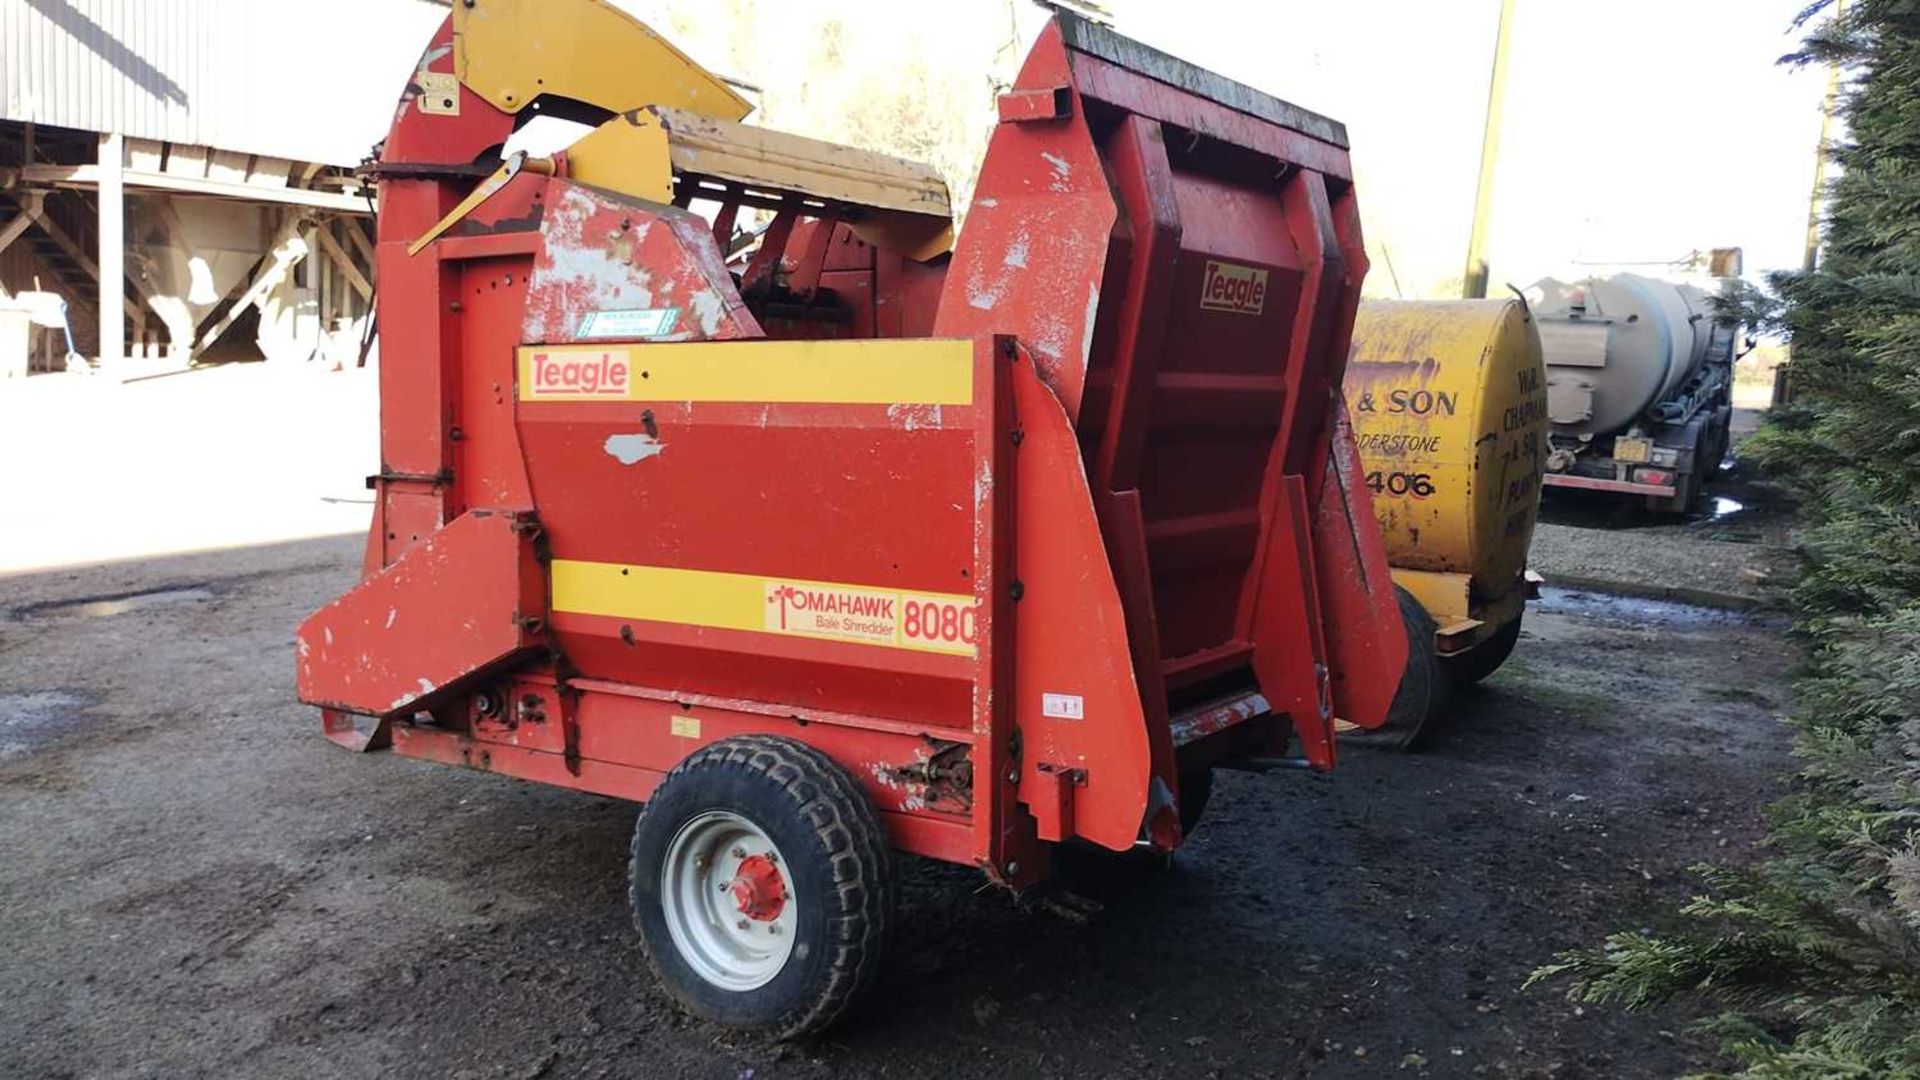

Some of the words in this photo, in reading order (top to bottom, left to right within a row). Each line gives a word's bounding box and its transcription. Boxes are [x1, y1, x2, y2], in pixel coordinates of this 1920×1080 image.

[1204, 263, 1264, 311] Teagle
[533, 353, 627, 394] Teagle
[1358, 393, 1376, 413] &
[1388, 389, 1458, 416] SON
[1365, 471, 1436, 497] 406
[816, 615, 841, 631] Bale
[842, 617, 895, 637] Shredder
[904, 601, 976, 645] 8080
